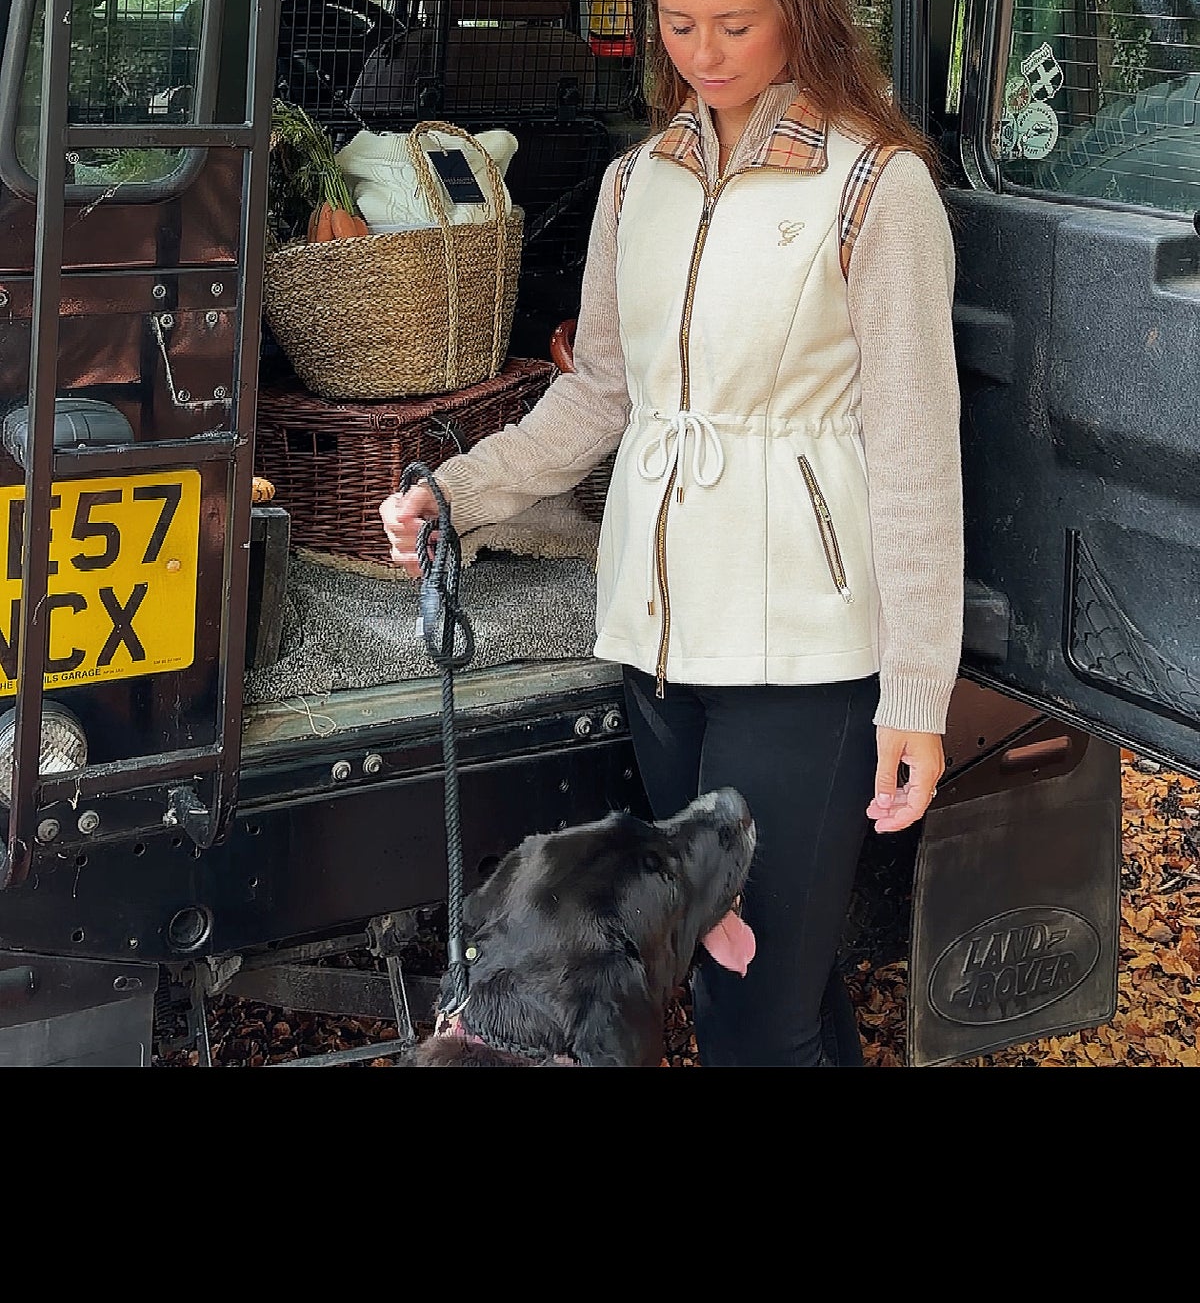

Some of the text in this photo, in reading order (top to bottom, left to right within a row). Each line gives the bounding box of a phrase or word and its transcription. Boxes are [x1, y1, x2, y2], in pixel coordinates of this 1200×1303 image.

[61, 668, 101, 682] GARAGE
[961, 923, 1049, 976] LAND
[967, 951, 1078, 1008] ROVER
